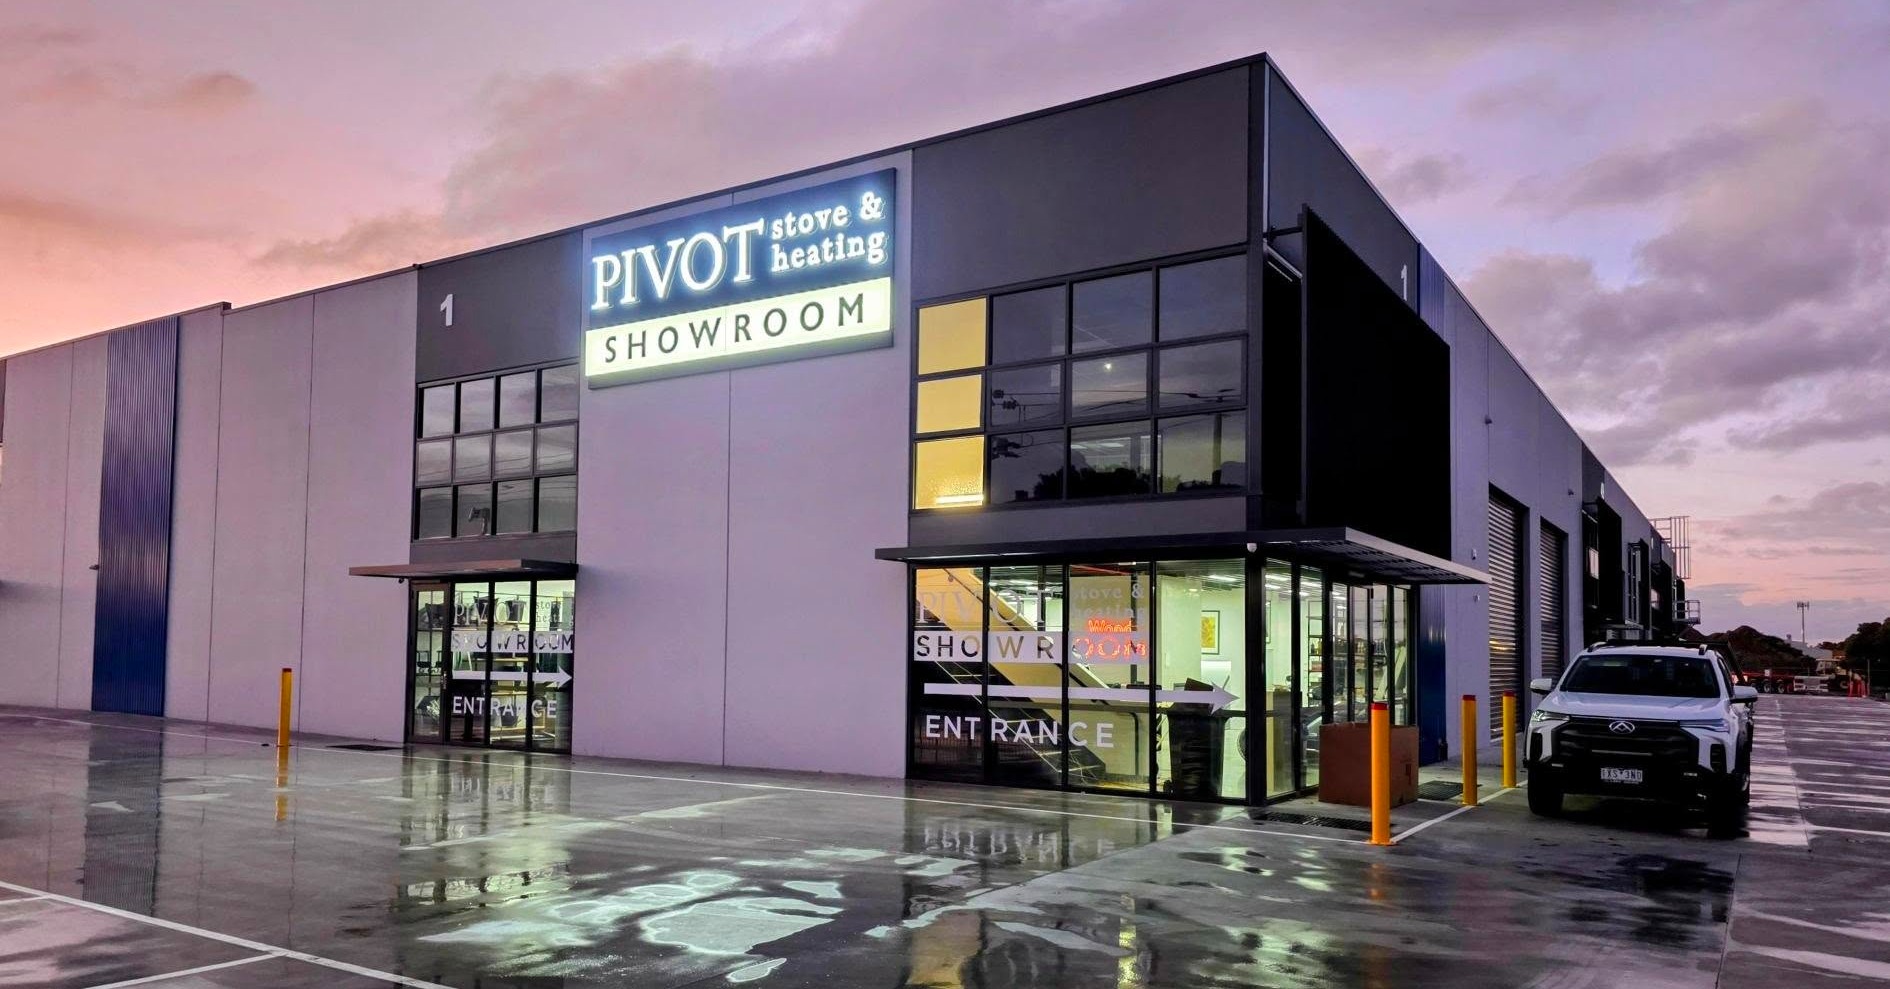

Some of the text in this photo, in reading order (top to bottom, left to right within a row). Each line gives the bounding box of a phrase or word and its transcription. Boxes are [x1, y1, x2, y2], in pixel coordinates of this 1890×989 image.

[772, 191, 886, 240] stove &
[591, 217, 764, 310] PIVOT
[771, 231, 889, 272] heating
[440, 293, 453, 326] 1
[605, 293, 864, 363] SHOWROOM
[915, 589, 1058, 624] PIVOT
[1131, 583, 1145, 599] &
[453, 696, 557, 719] ENTRANCE
[925, 714, 1115, 749] ENTRANCE
